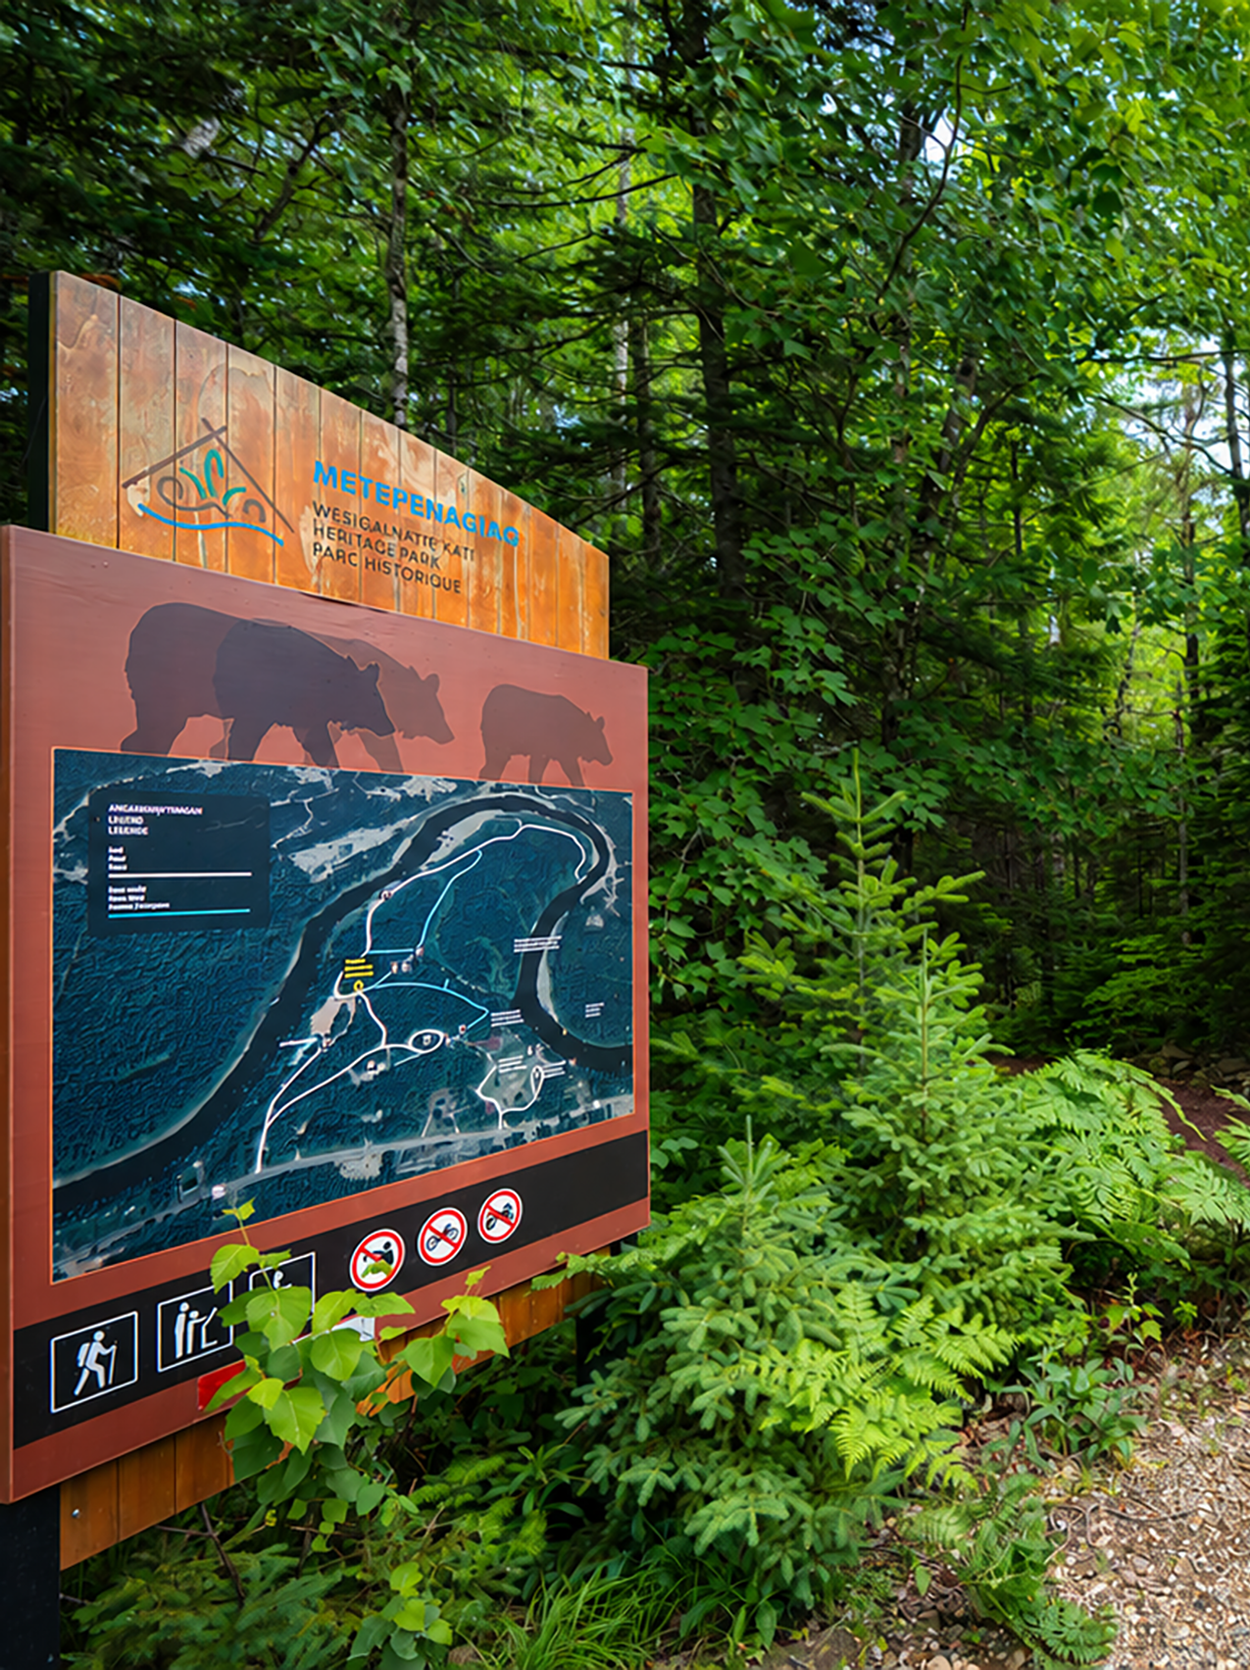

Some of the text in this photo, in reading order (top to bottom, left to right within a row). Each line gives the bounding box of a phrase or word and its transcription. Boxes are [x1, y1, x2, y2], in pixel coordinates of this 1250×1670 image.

[313, 460, 520, 548] METEPENAGIAQ
[313, 518, 441, 570] HERITAGE PARK
[313, 542, 461, 594] PARC HISTORIQUE
